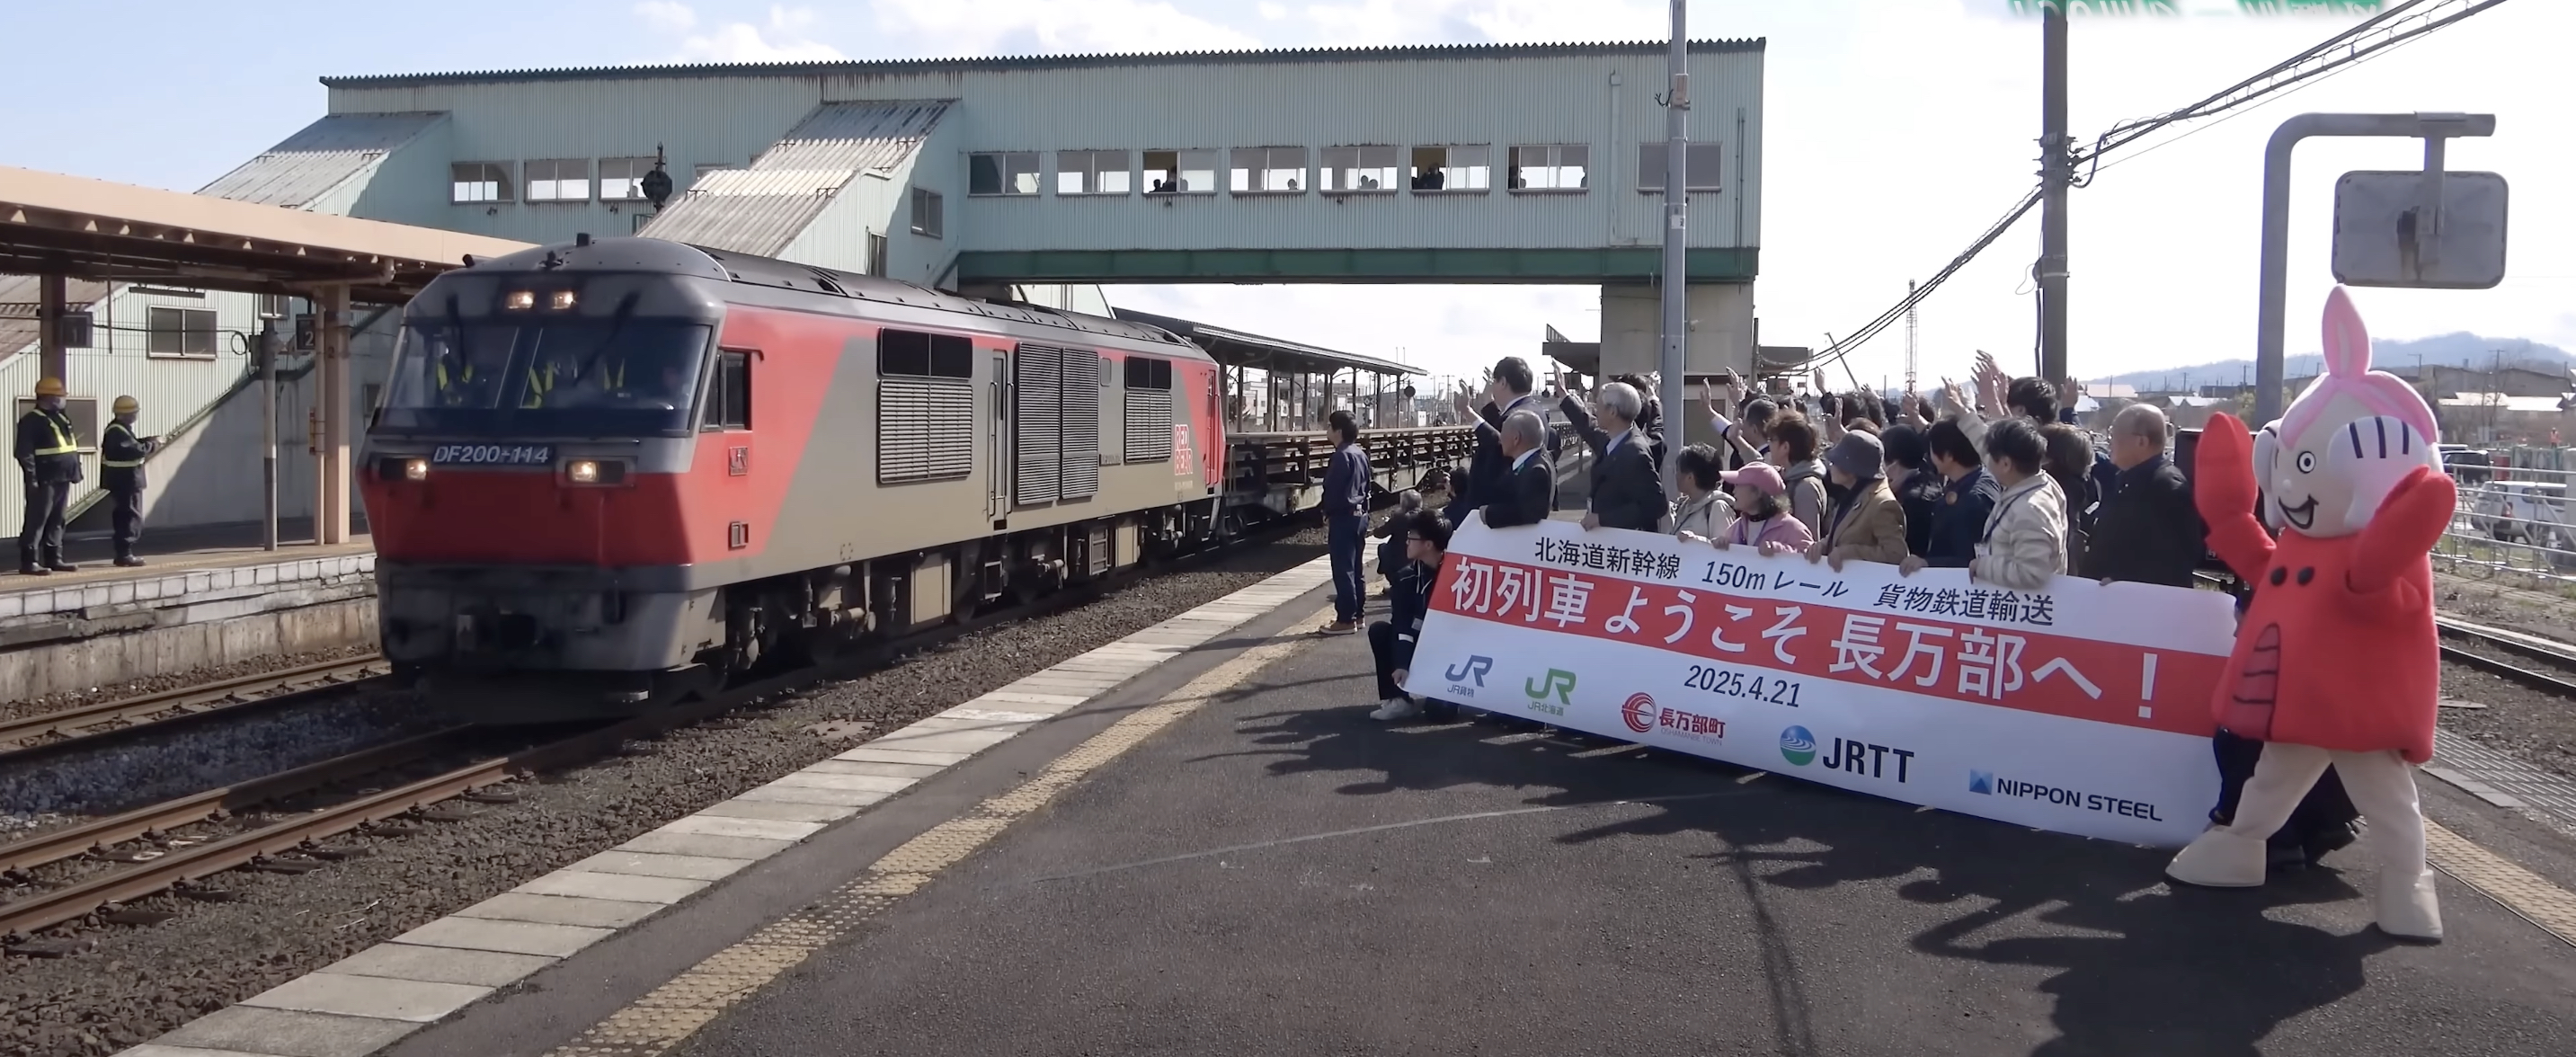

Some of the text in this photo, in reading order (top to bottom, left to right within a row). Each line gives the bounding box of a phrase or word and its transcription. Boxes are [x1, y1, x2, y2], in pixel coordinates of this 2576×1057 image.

[305, 331, 314, 346] 2
[1174, 423, 1189, 449] RED
[433, 445, 548, 463] DF200-114
[1174, 449, 1194, 475] BEAR
[1534, 537, 2054, 626] 北海道新幹線 150m レール 貨物鉄道輸送
[1450, 555, 2157, 719] 初列車 ようこそ 長万部へ！
[1444, 654, 1493, 688] JR
[1524, 668, 1577, 706] JR
[1683, 664, 1800, 708] 2025.4.21
[1527, 701, 1565, 717] JR北海道
[1658, 706, 1726, 739] 長万部町
[1823, 737, 1914, 784] JRTT
[1997, 777, 2163, 822] NIPPON STEEL
